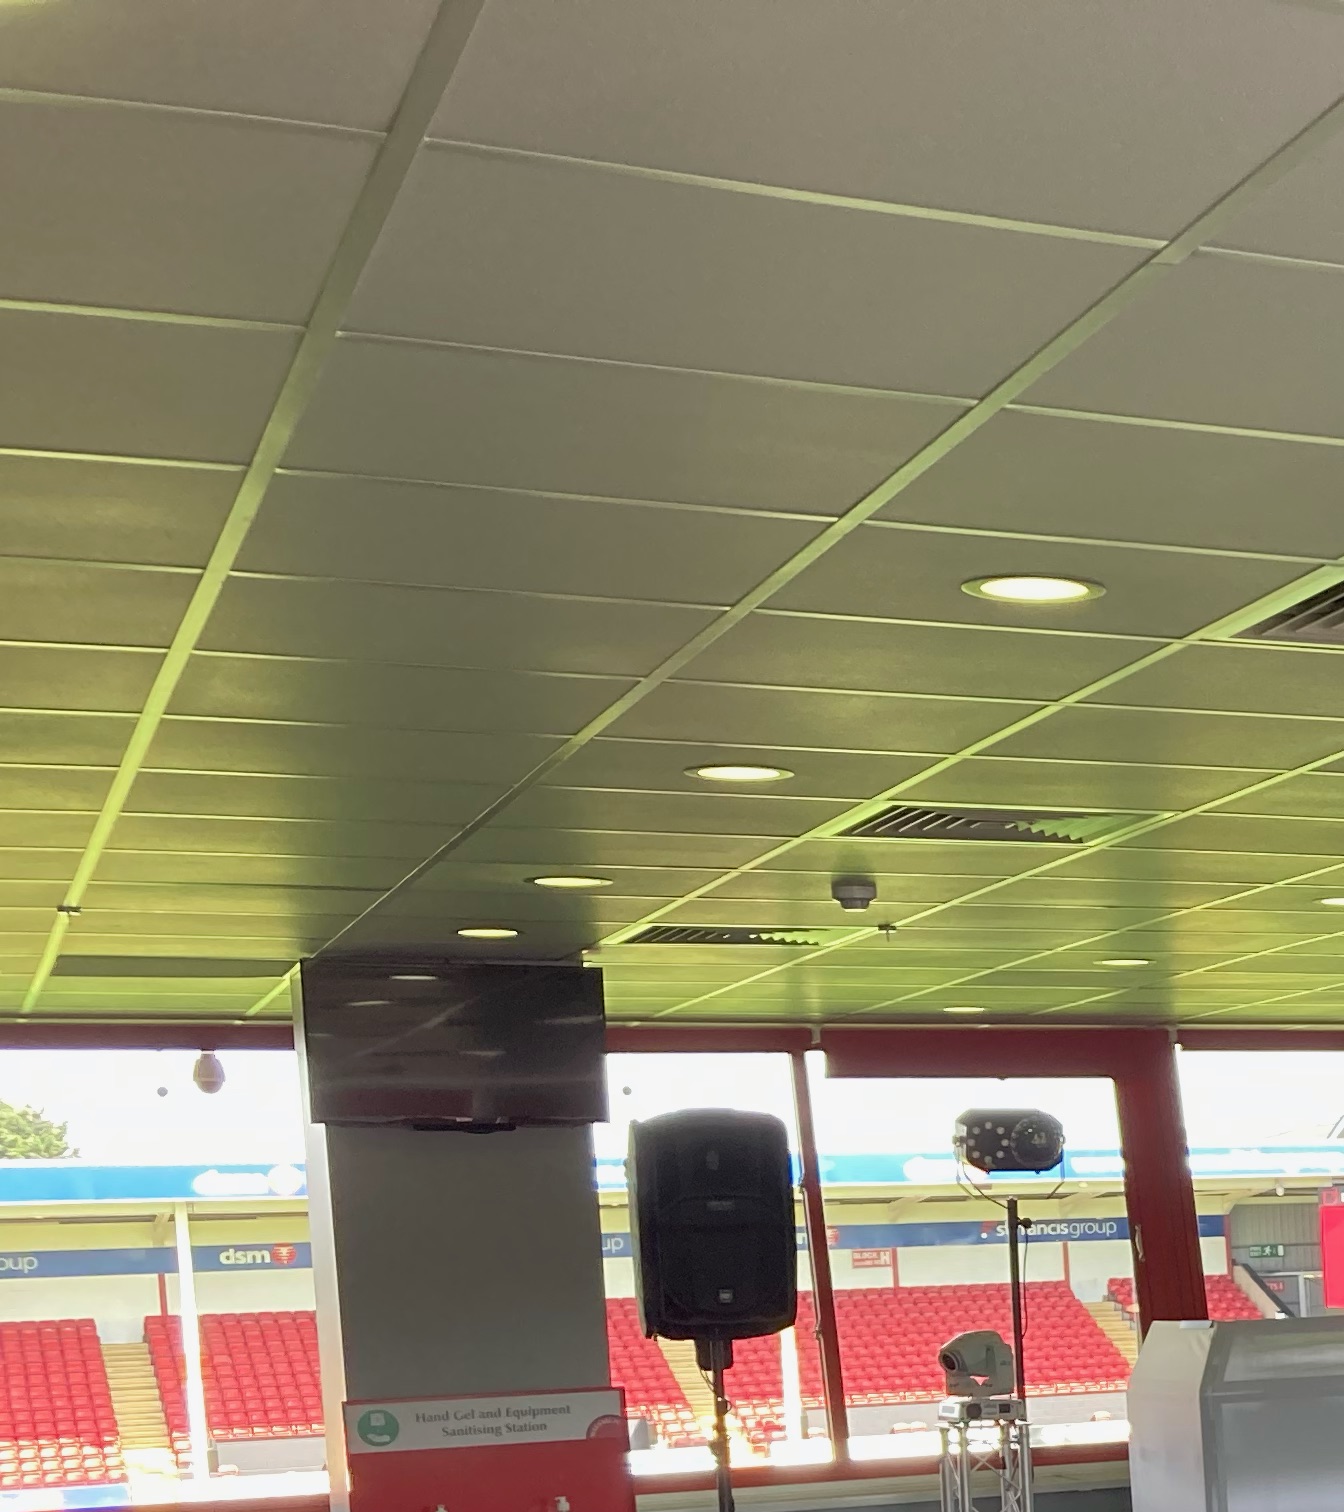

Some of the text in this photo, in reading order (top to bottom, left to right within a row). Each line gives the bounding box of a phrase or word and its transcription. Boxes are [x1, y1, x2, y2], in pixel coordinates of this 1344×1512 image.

[219, 1248, 271, 1265] dsm
[415, 1405, 572, 1423] Hand Gel and Equipment
[441, 1421, 548, 1438] Sanitising Station
